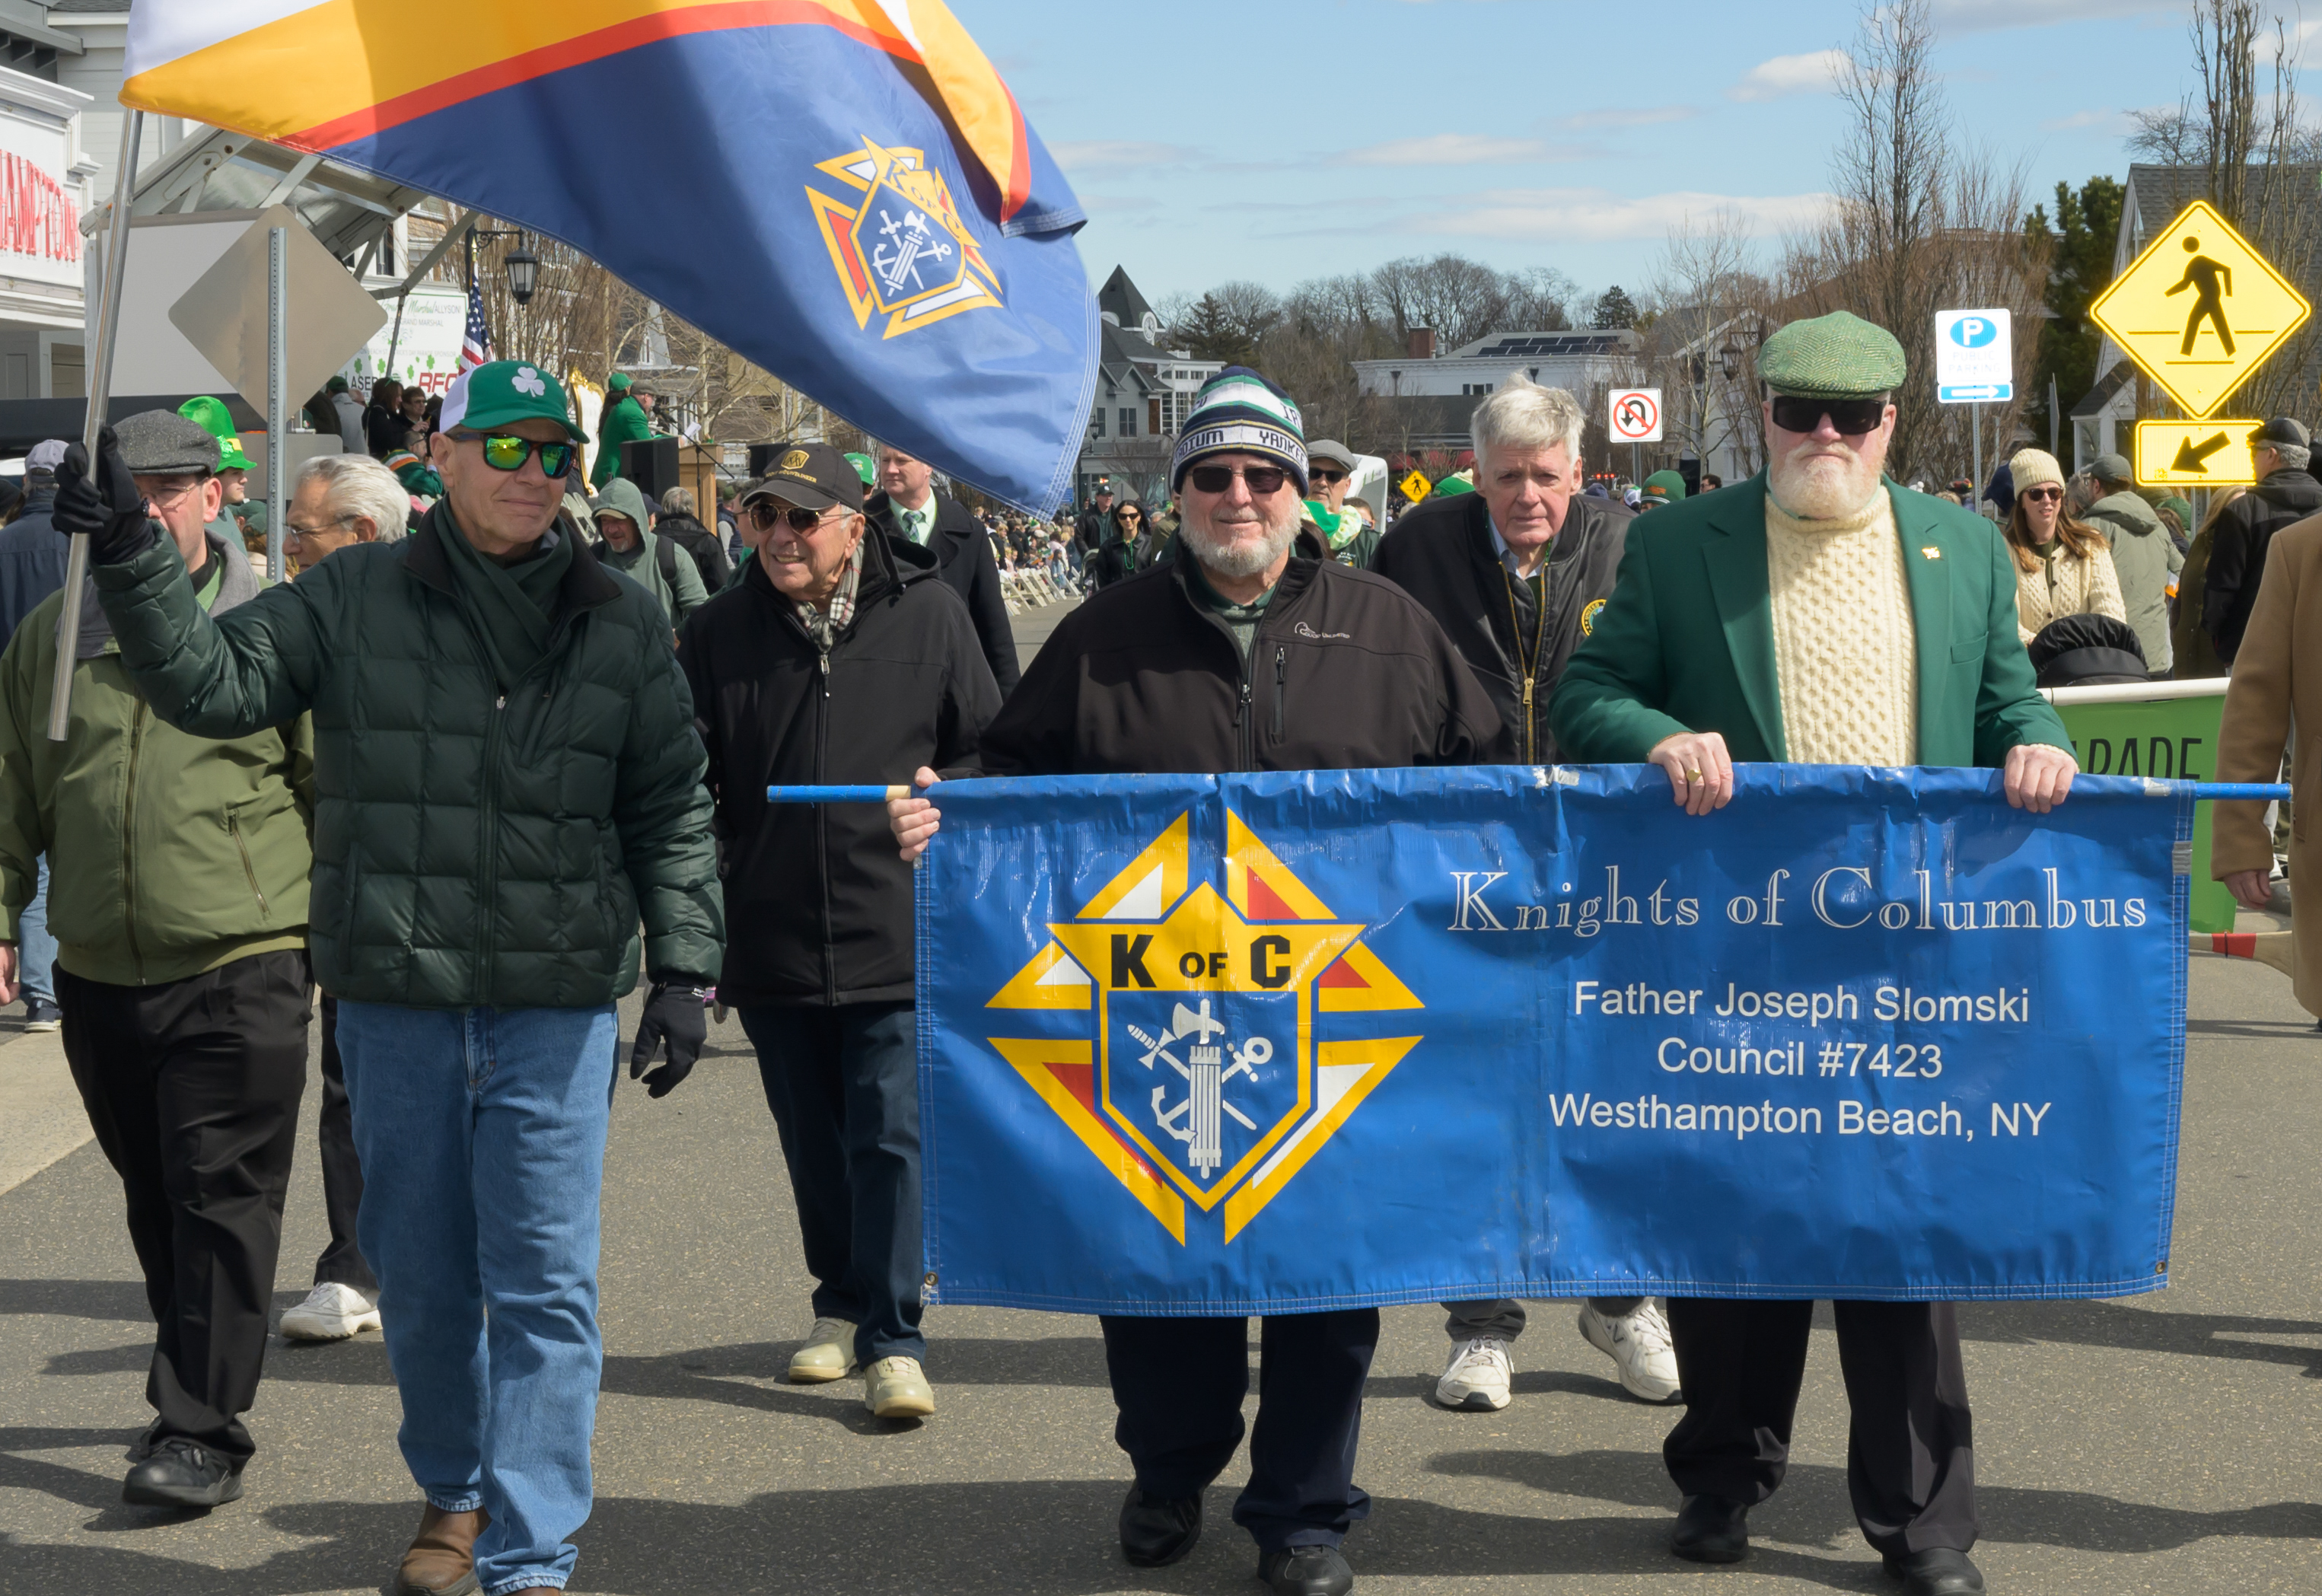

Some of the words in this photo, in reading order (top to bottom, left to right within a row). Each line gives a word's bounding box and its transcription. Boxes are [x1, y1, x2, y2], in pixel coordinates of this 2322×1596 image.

[0, 149, 81, 263] AMPTON
[1953, 350, 1996, 362] PUBLIC
[1963, 320, 1983, 346] P
[1948, 362, 2001, 374] PARKING
[1448, 865, 1699, 937] Knights
[1726, 868, 1790, 926] of
[1811, 866, 2147, 931] Columbus
[1110, 933, 1157, 989] K
[1179, 951, 1228, 979] OF
[1250, 934, 1291, 989] C
[1575, 981, 1703, 1015] Father
[1715, 983, 1859, 1027] Joseph
[1874, 986, 2028, 1022] Slomski
[1658, 1037, 1804, 1075] Council
[1818, 1042, 1943, 1078] #7423
[1550, 1093, 1822, 1140] Westhampton
[1839, 1100, 1973, 1142] Beach,
[1991, 1102, 2052, 1137] NY
